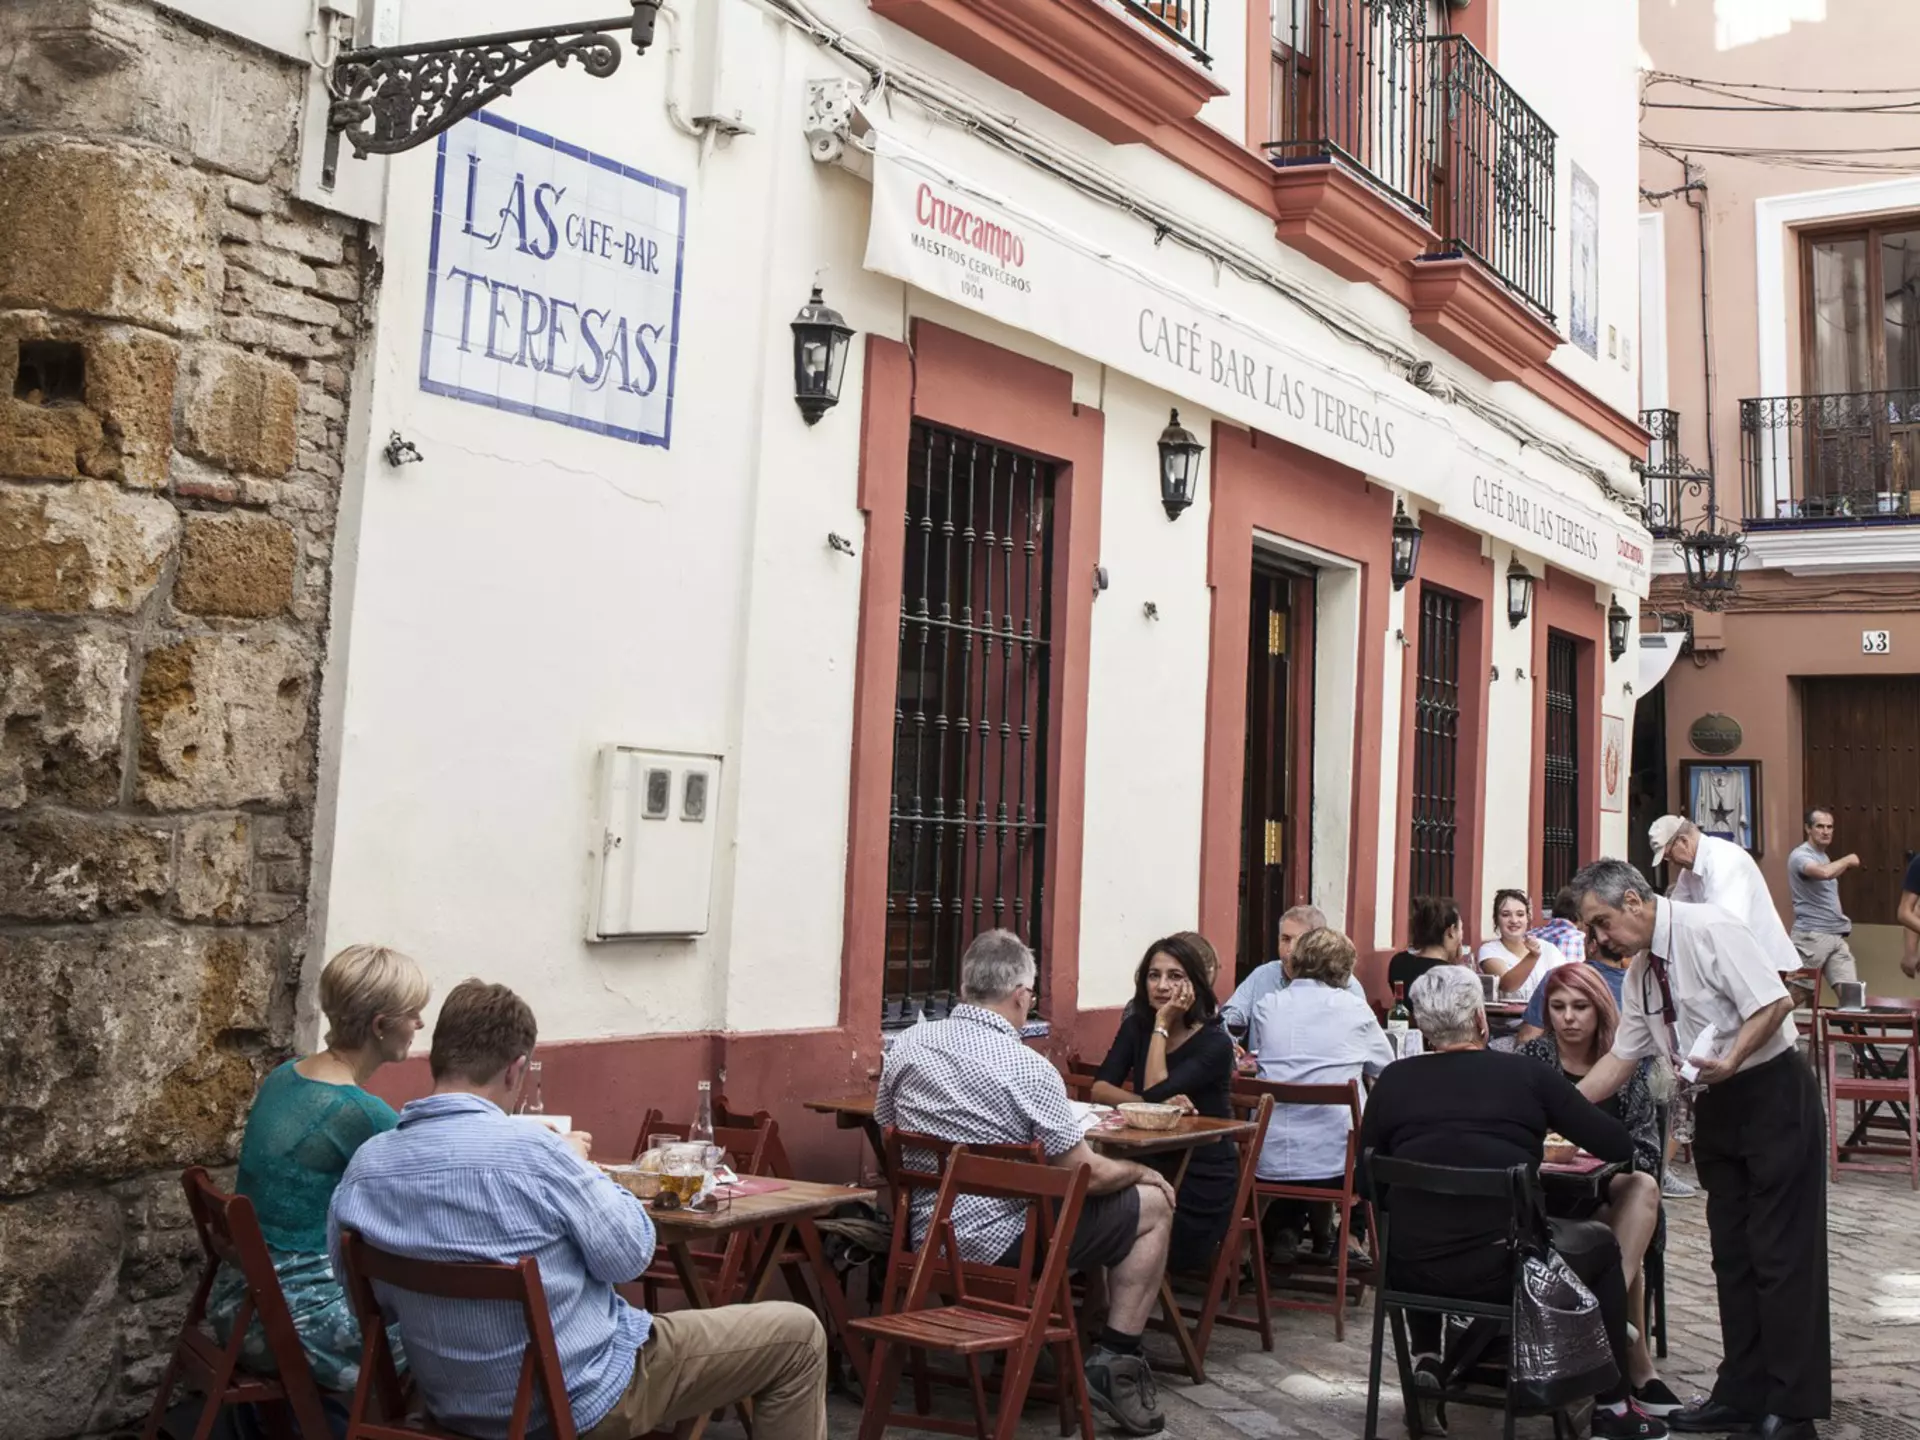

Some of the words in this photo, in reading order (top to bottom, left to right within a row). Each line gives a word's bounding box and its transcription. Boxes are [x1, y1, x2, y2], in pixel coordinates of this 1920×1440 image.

[461, 153, 567, 261] LAS
[916, 183, 1024, 269] Cruzcampo
[911, 232, 966, 266] MAESTROS
[968, 258, 1031, 293] CERVECEROS
[961, 281, 984, 301] 1904
[446, 265, 665, 397] TERESAS
[1138, 308, 1202, 375] CAFÉ
[1209, 339, 1258, 401] BAR
[1264, 364, 1306, 420] LAS
[1311, 386, 1395, 459] TERESAS
[1473, 475, 1505, 518] CAFÉ
[1507, 490, 1530, 531] BAR
[1533, 503, 1554, 540] LAS
[1556, 514, 1598, 560] TERESAS
